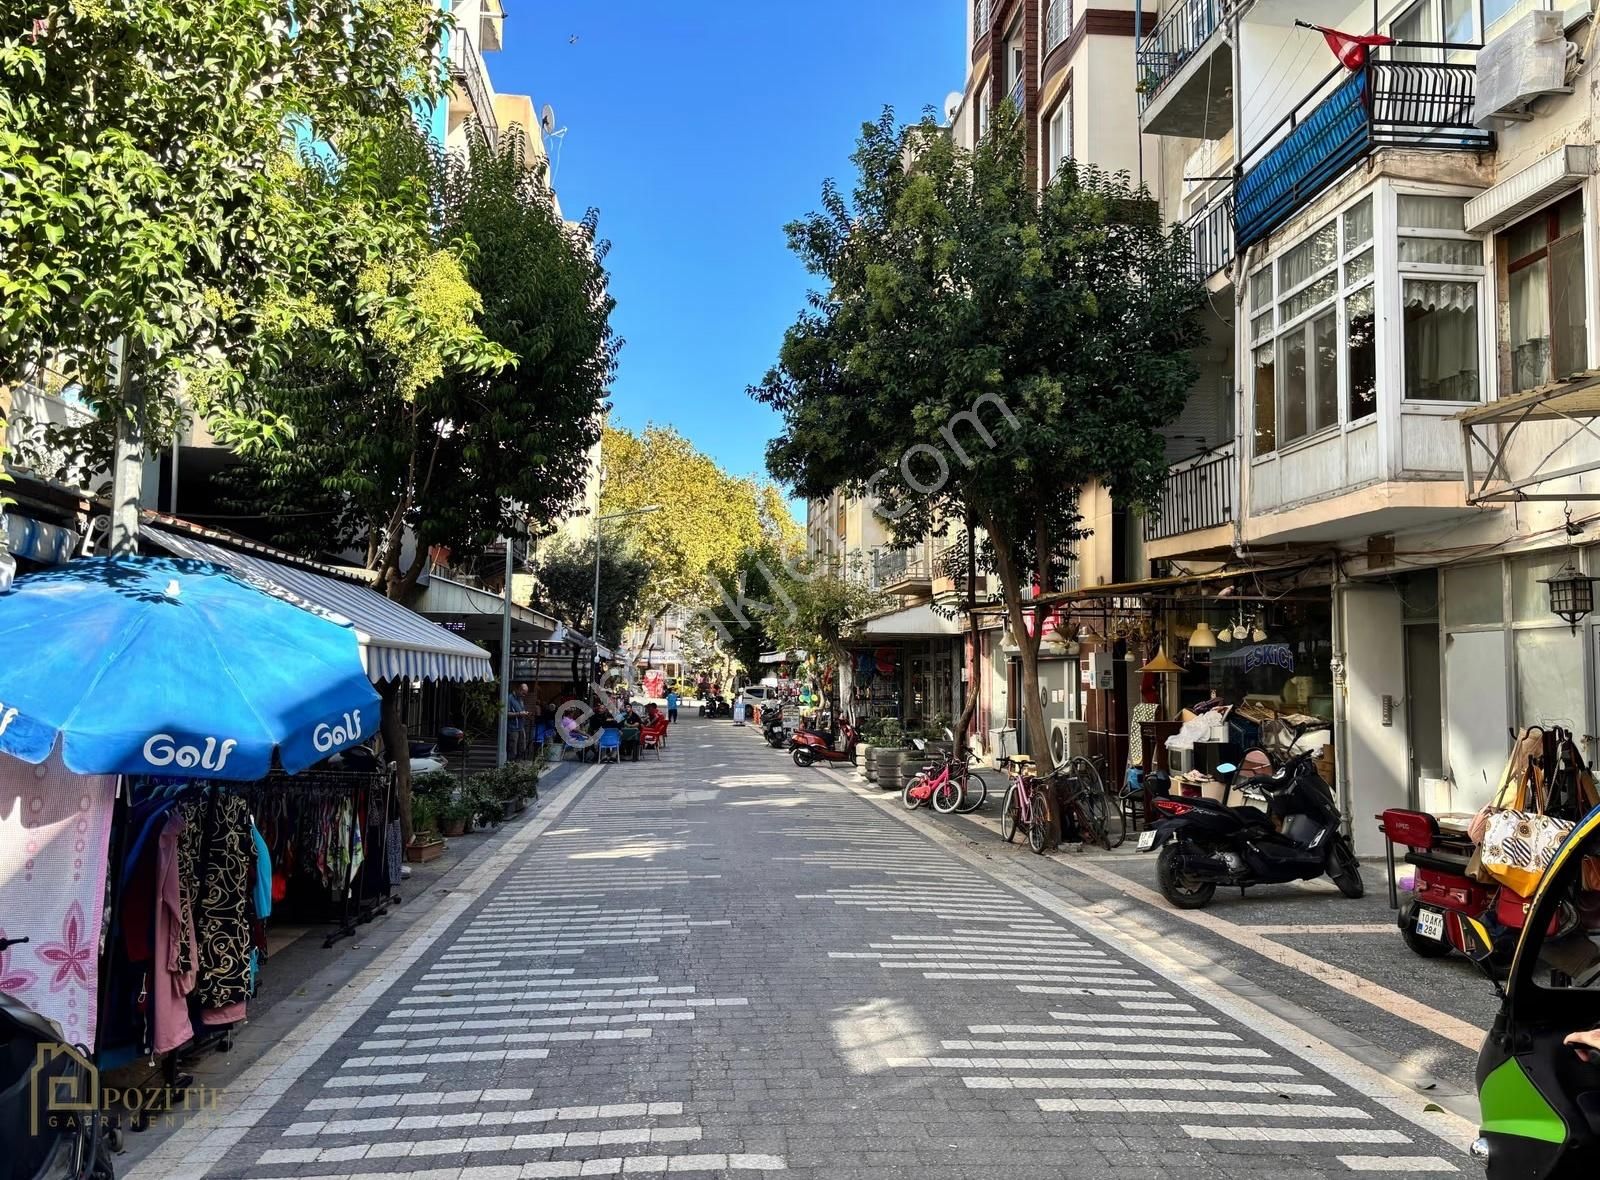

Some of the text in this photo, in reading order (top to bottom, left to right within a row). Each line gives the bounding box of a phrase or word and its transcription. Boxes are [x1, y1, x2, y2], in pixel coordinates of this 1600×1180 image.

[313, 709, 361, 752] Golf
[143, 734, 238, 771] Golf
[1423, 924, 1437, 936] 284
